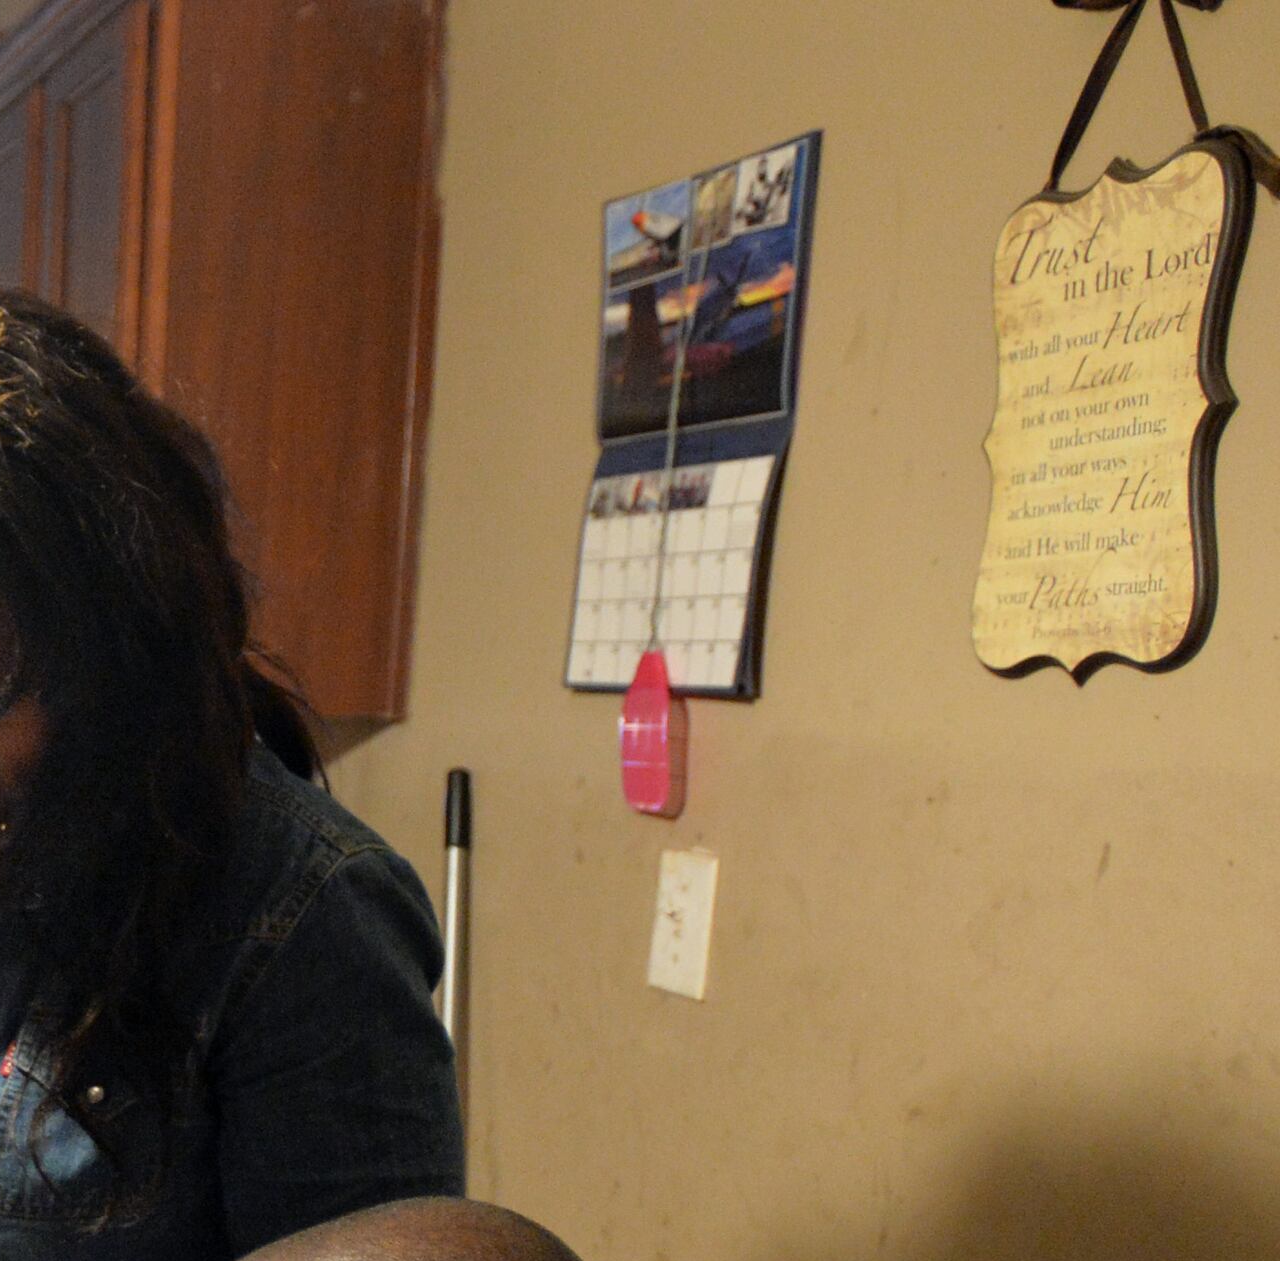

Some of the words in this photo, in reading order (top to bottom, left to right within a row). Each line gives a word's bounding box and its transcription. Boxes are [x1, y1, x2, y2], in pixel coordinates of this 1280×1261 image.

[1004, 213, 1105, 285] Trust
[1064, 272, 1086, 301] in
[1095, 260, 1133, 293] the
[1144, 232, 1213, 281] Lord
[1008, 340, 1038, 363] with
[1043, 334, 1061, 356] all
[1065, 330, 1101, 352] your
[1102, 300, 1191, 349] Heart
[1022, 376, 1050, 399] and
[1064, 354, 1135, 393] Lean
[1021, 411, 1045, 430] not
[1050, 407, 1070, 424] on
[1074, 401, 1111, 424] your
[1114, 392, 1150, 411] own
[1010, 469, 1026, 486] in
[1030, 463, 1048, 483] all
[1052, 460, 1088, 481] your
[1091, 456, 1128, 476] ways
[1007, 491, 1104, 521] acknowledge
[1109, 470, 1173, 514] Him
[1004, 540, 1032, 561] and
[1036, 537, 1059, 557] He
[1064, 531, 1091, 552] will
[1096, 528, 1141, 551] make
[996, 588, 1028, 609] your
[1027, 566, 1103, 611] Paths
[1104, 572, 1169, 597] straight.
